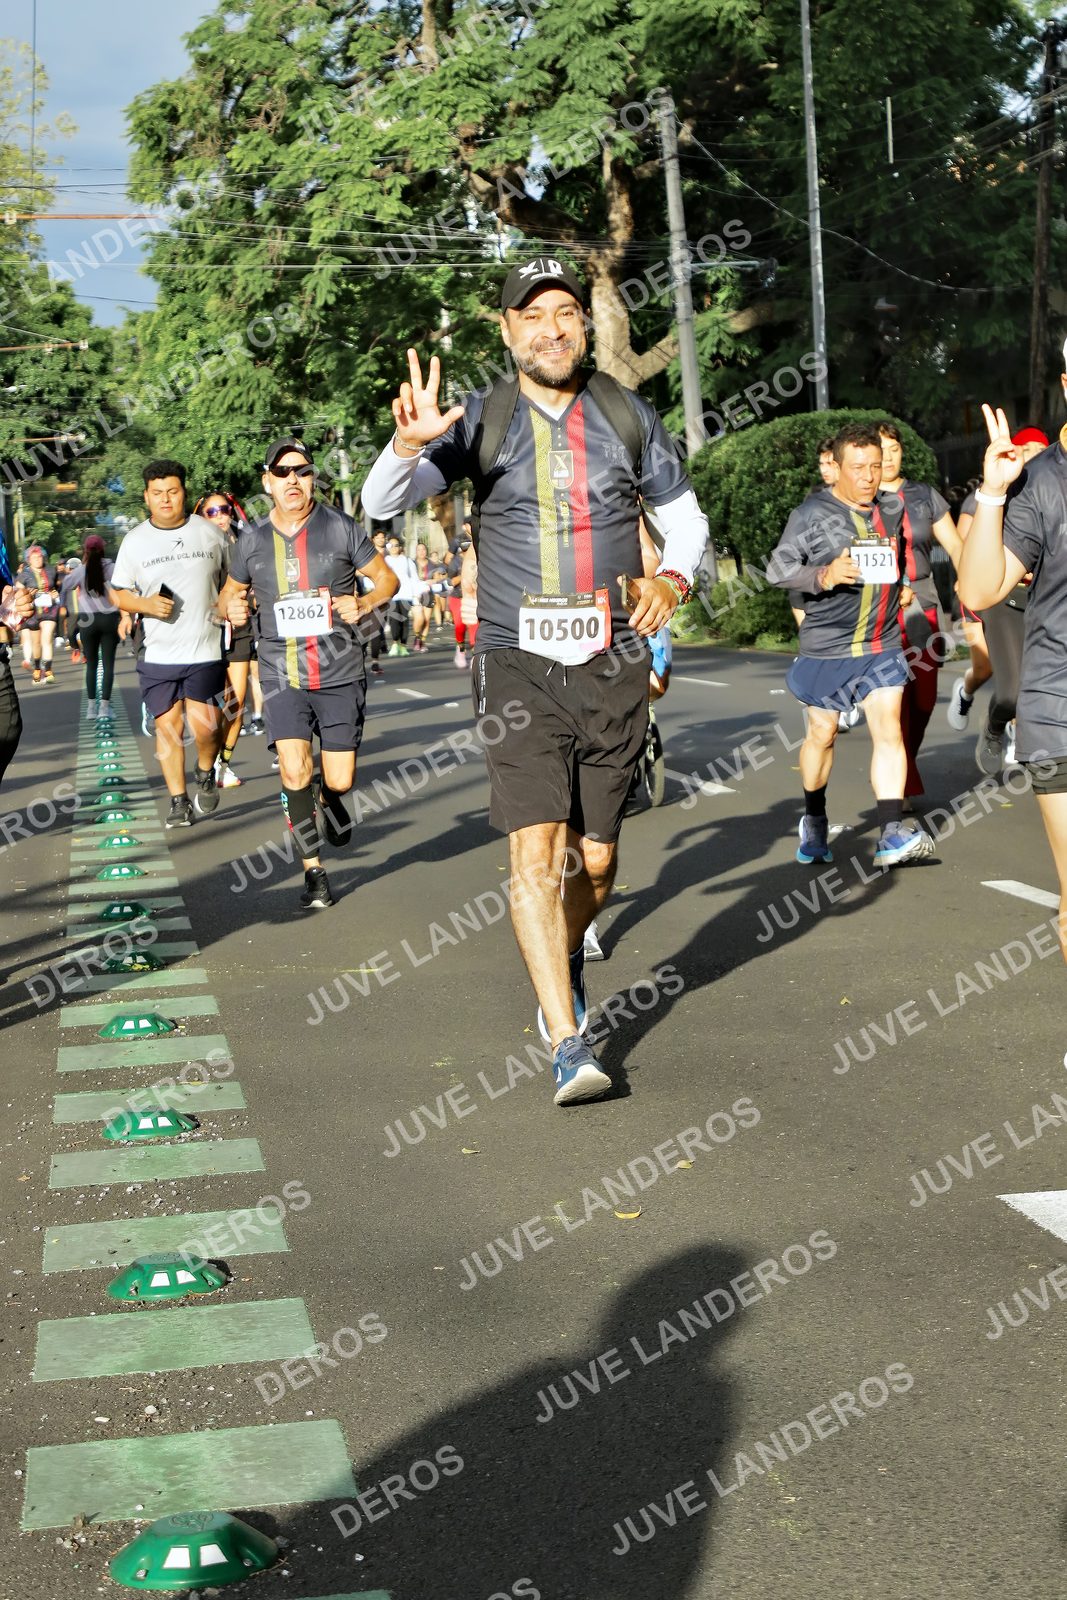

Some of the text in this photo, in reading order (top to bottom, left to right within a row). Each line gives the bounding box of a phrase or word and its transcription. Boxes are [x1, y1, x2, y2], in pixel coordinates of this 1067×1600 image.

[854, 553, 893, 567] 11521
[278, 604, 325, 620] 12862
[525, 616, 600, 641] 10500
